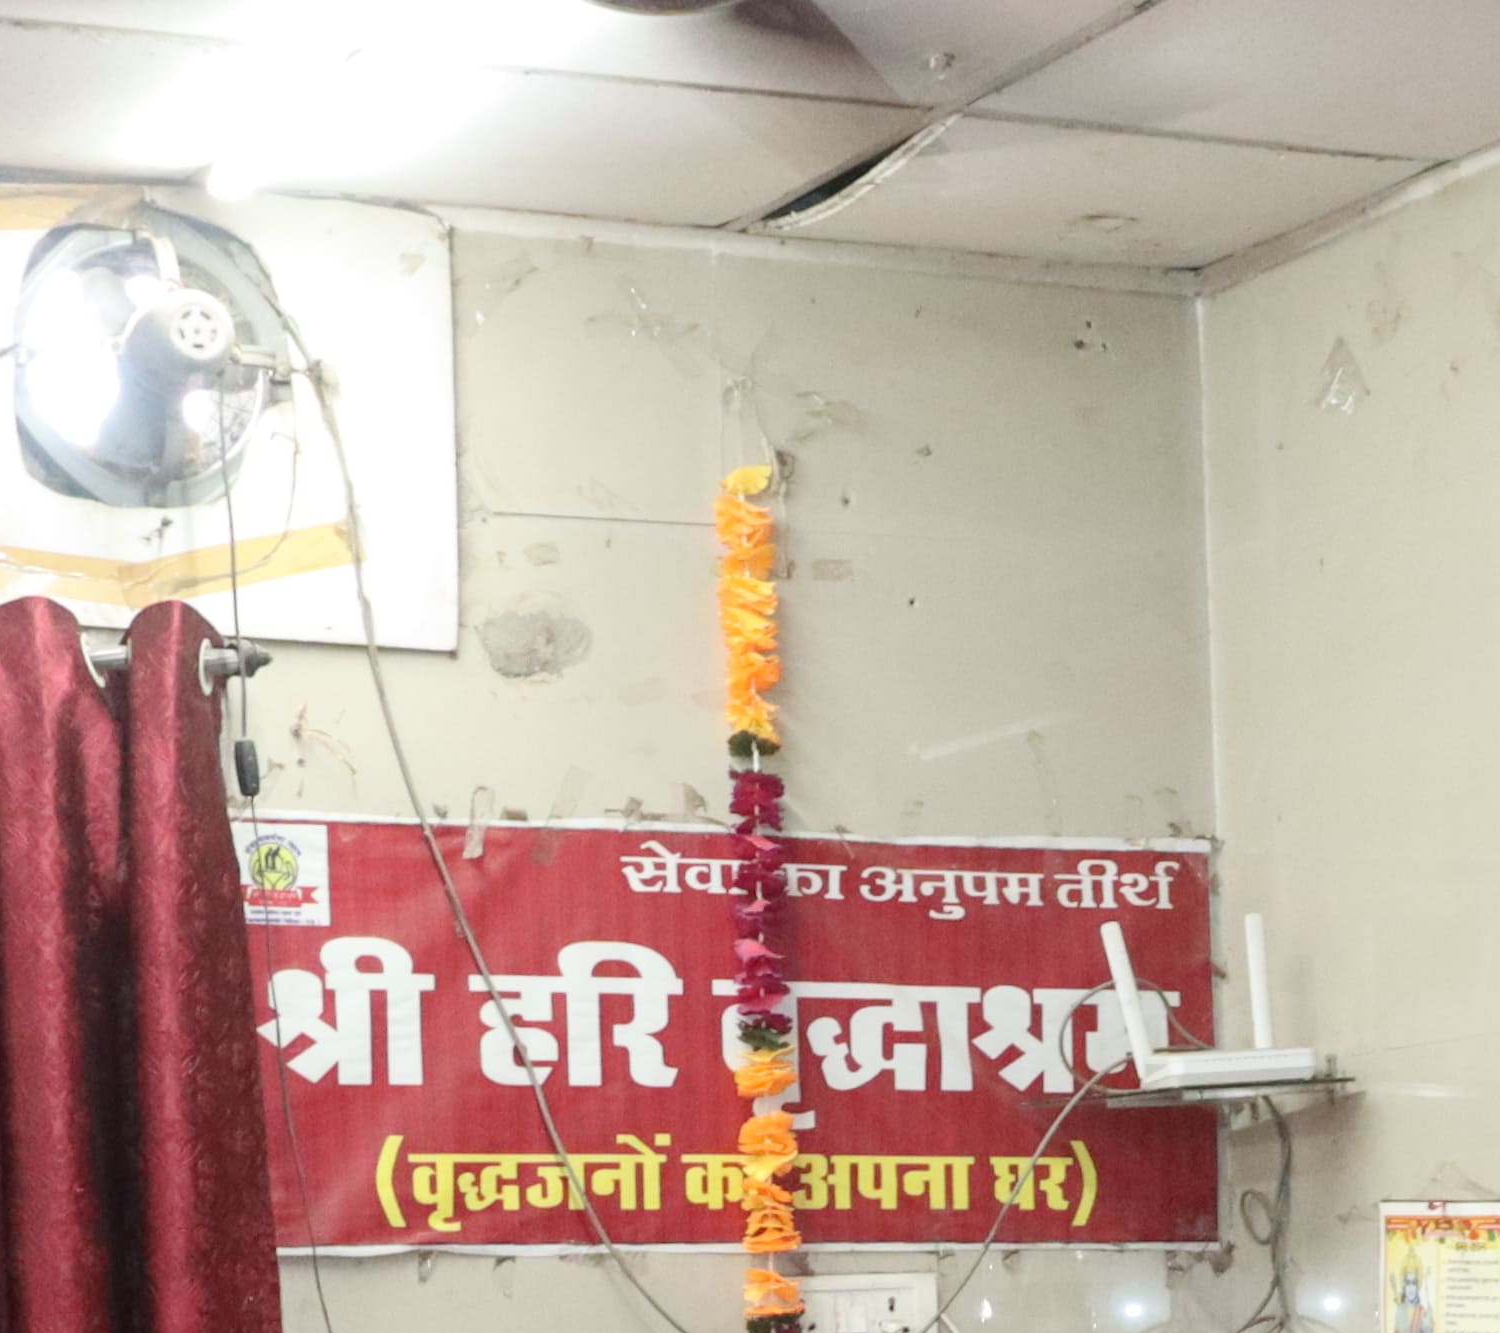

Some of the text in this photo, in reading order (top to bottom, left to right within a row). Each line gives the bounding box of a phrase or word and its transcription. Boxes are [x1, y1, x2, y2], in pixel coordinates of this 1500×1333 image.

[620, 841, 748, 895] सेवा
[859, 865, 1045, 921] अनुपम
[1054, 859, 1180, 910] तीर्थ
[256, 936, 435, 1086] श्री
[468, 940, 683, 1087] हरि
[375, 1134, 1098, 1232] (वृद्धजनों क अपना घर)
